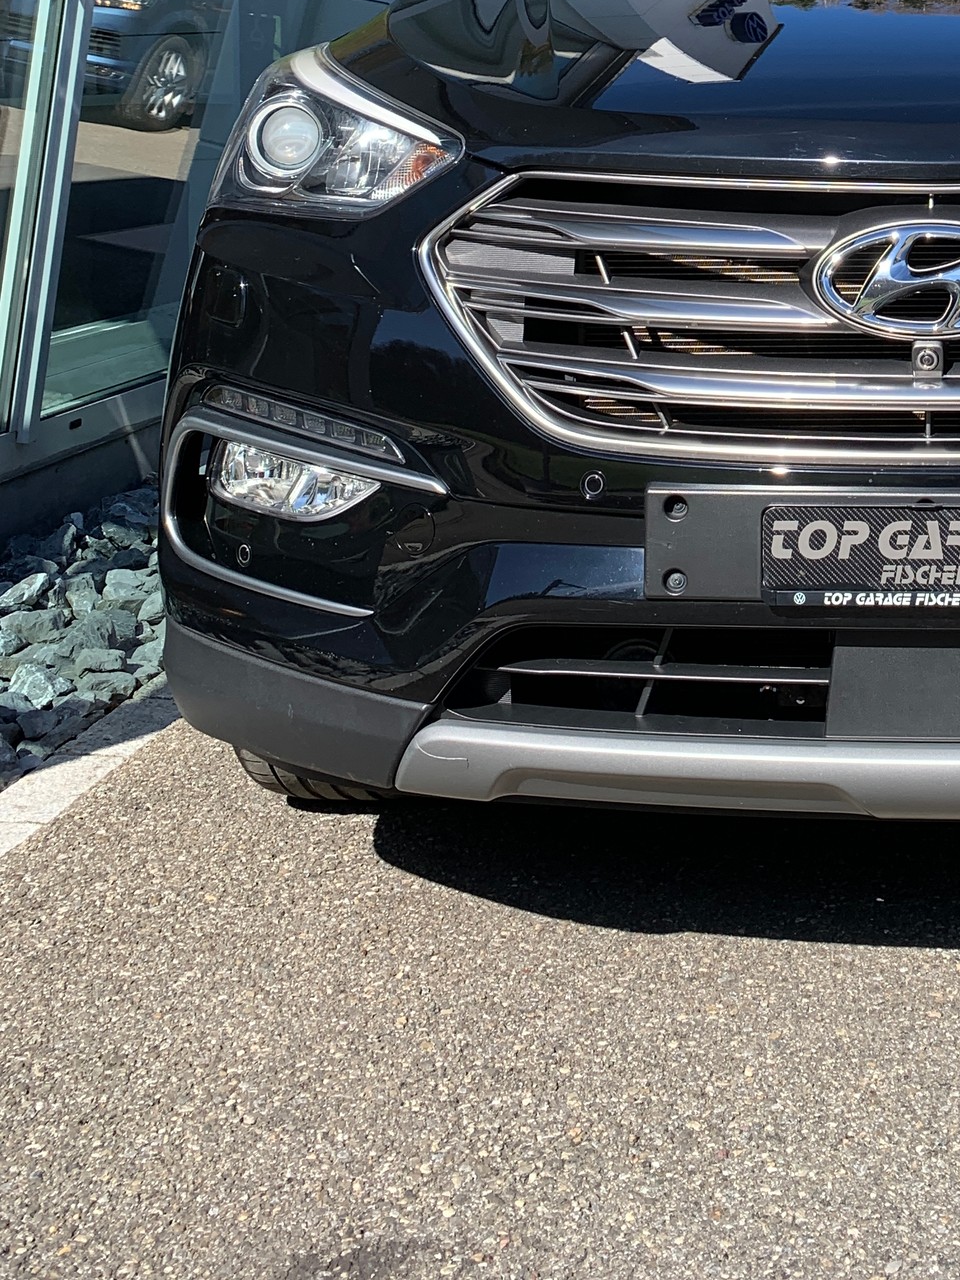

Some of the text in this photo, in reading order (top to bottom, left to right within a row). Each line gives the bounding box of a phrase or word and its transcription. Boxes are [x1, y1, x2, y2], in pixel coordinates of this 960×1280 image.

[771, 520, 870, 560] TOP
[823, 592, 852, 605] TOP
[856, 593, 911, 606] GARAGE
